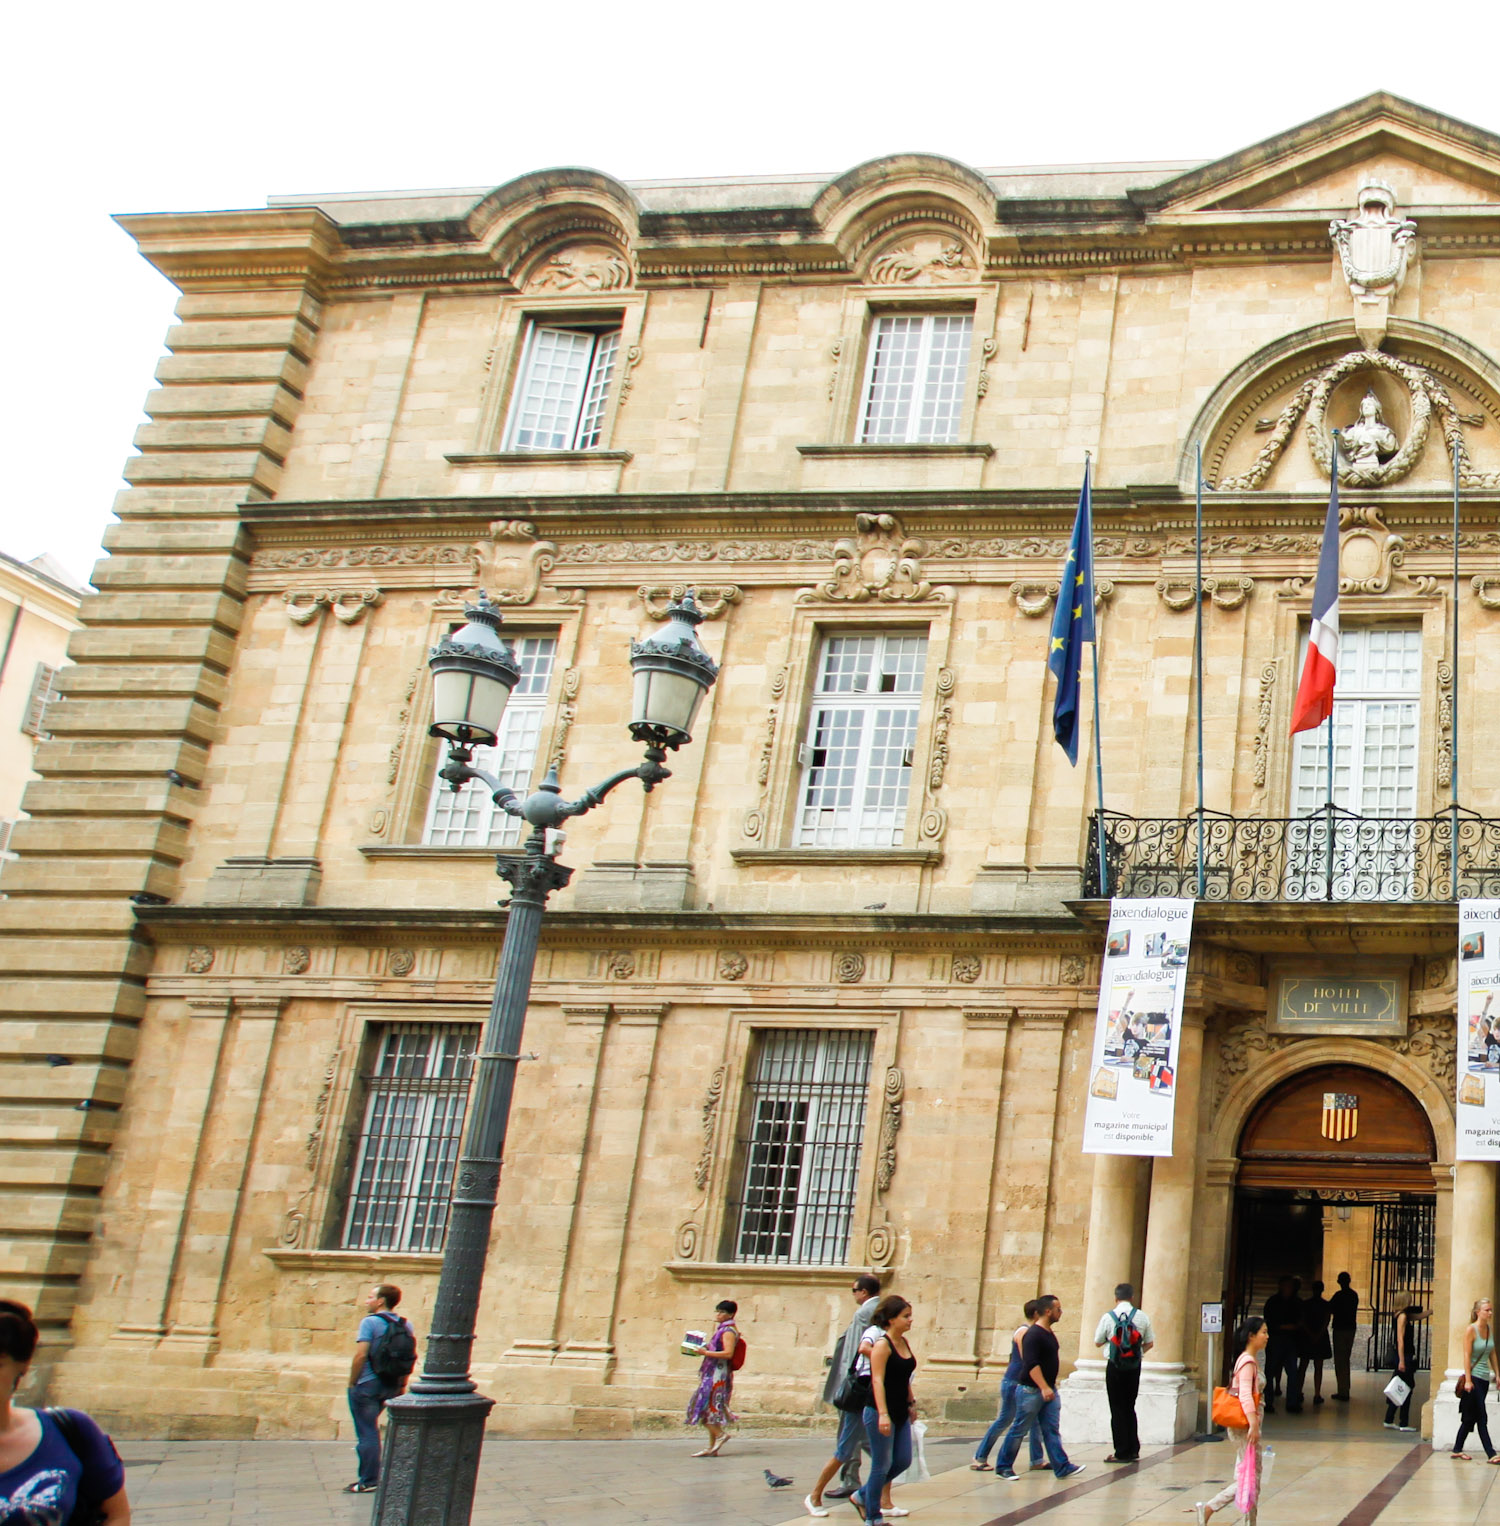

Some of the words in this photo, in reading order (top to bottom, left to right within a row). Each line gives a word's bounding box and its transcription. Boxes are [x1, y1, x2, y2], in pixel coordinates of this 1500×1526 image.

[1112, 906, 1188, 922] aixendialogue
[1114, 970, 1175, 982] aixendialogue
[1313, 988, 1361, 999] HOTEL
[1304, 1002, 1323, 1013] DE
[1331, 1003, 1369, 1014] VILLE
[1122, 1111, 1141, 1119] Votre
[1094, 1121, 1130, 1131] magazine
[1131, 1123, 1168, 1132] municipal
[1115, 1133, 1154, 1142] disponible
[1465, 1128, 1500, 1137] magazine
